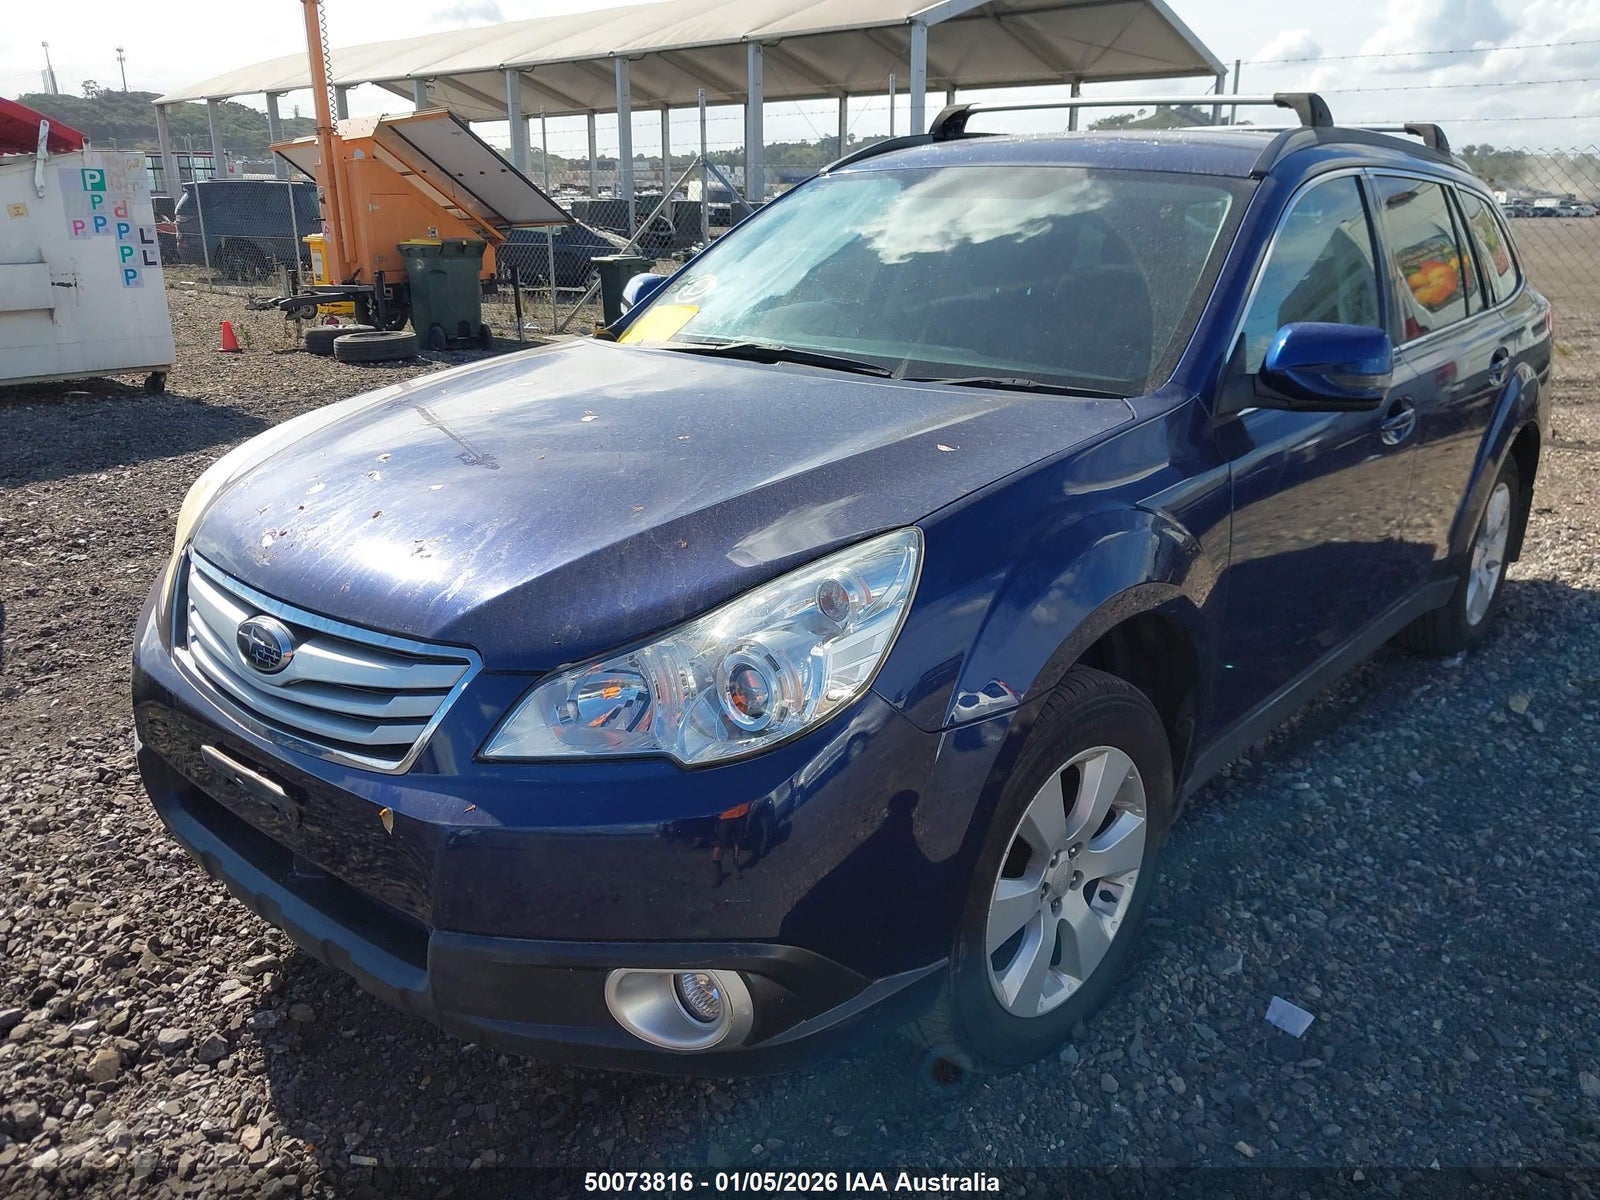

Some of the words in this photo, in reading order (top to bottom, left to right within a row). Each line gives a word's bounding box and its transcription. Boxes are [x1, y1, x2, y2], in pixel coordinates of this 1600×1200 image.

[84, 169, 100, 191] P
[91, 194, 103, 209] P
[73, 219, 85, 235] P
[93, 215, 107, 233] P
[117, 222, 130, 239] P
[139, 227, 154, 244] L
[120, 245, 133, 263] P
[143, 249, 157, 266] L
[124, 268, 137, 285] P
